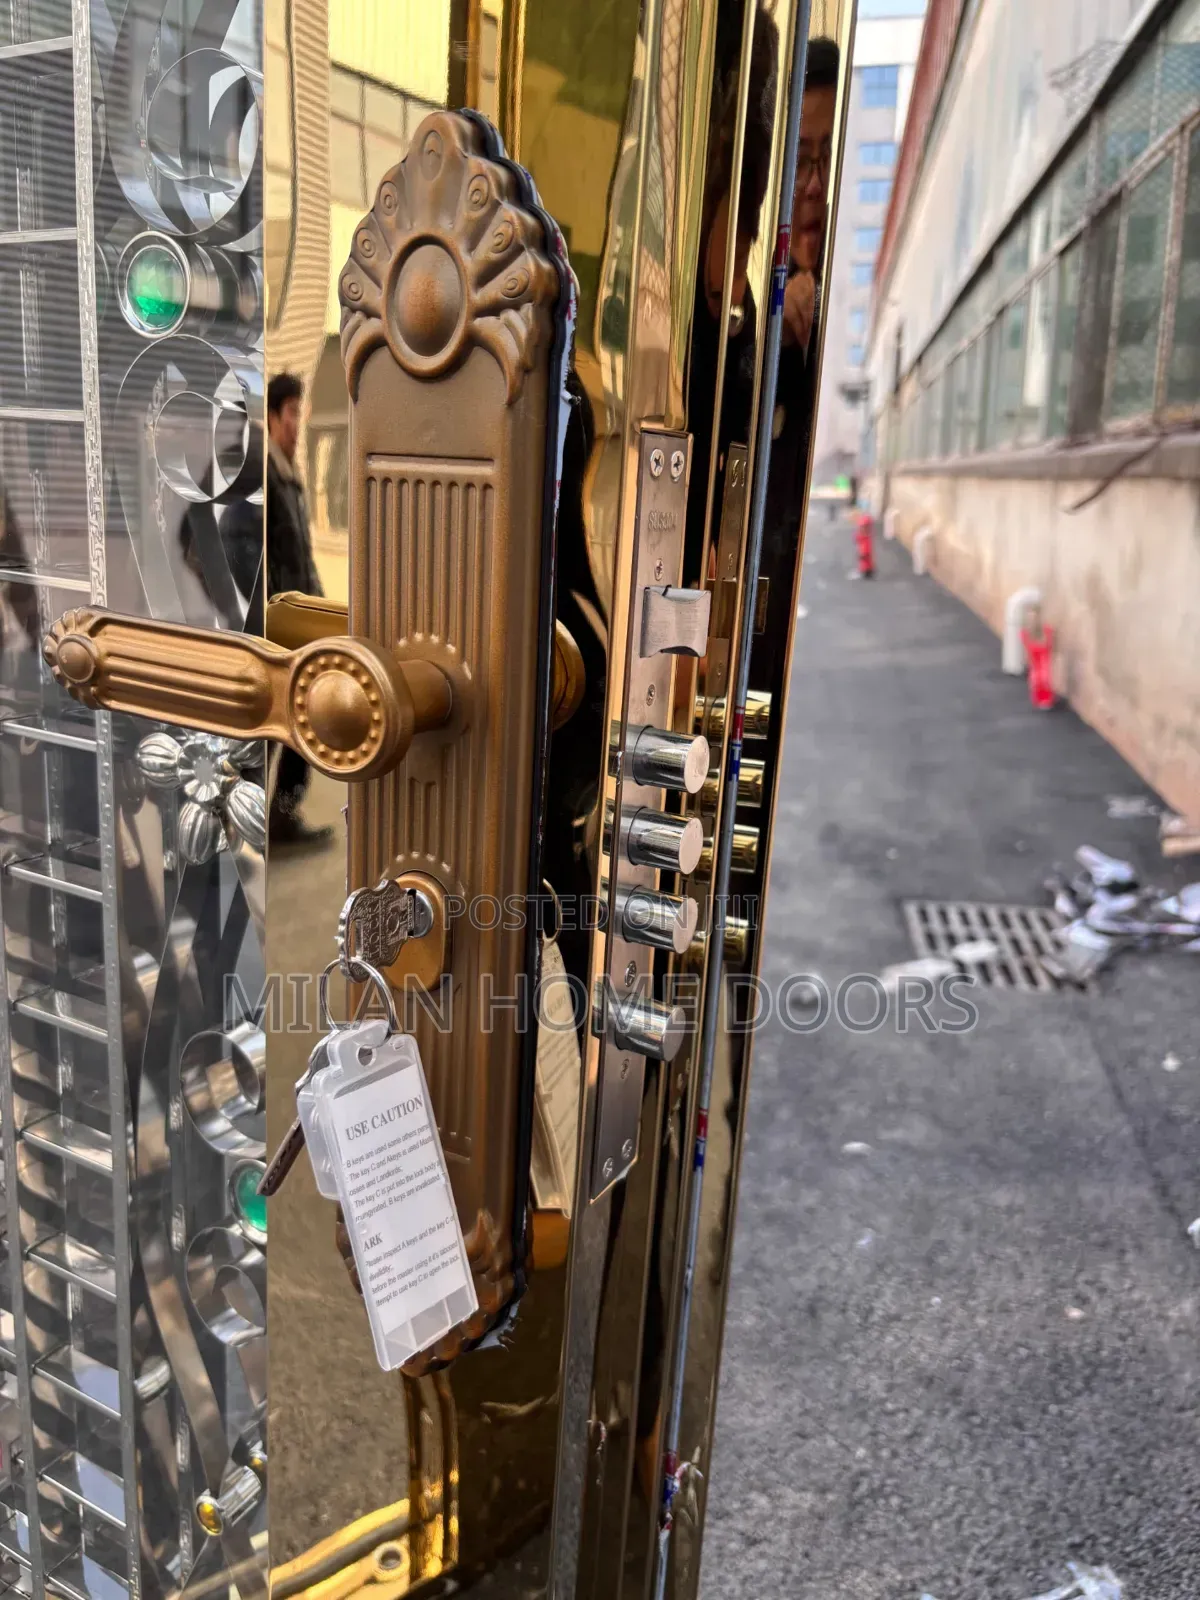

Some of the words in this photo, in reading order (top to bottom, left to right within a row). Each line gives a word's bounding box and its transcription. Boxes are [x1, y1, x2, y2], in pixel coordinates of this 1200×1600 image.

[345, 1120, 370, 1141] USE
[371, 1095, 424, 1129] CAUTION
[352, 1154, 365, 1166] keys
[365, 1150, 374, 1158] are
[374, 1143, 387, 1154] used
[388, 1137, 401, 1147] some
[350, 1171, 360, 1180] The
[360, 1166, 370, 1177] key
[376, 1158, 386, 1167] and
[355, 1198, 365, 1207] The
[365, 1192, 376, 1203] key
[386, 1183, 395, 1193] put
[396, 1177, 405, 1186] into
[406, 1173, 414, 1181] the
[366, 1178, 376, 1187] and
[394, 1191, 406, 1203] keys
[418, 1229, 428, 1239] and
[428, 1225, 436, 1233] the
[437, 1220, 446, 1231] key
[441, 1260, 449, 1268] the
[388, 1276, 396, 1284] the
